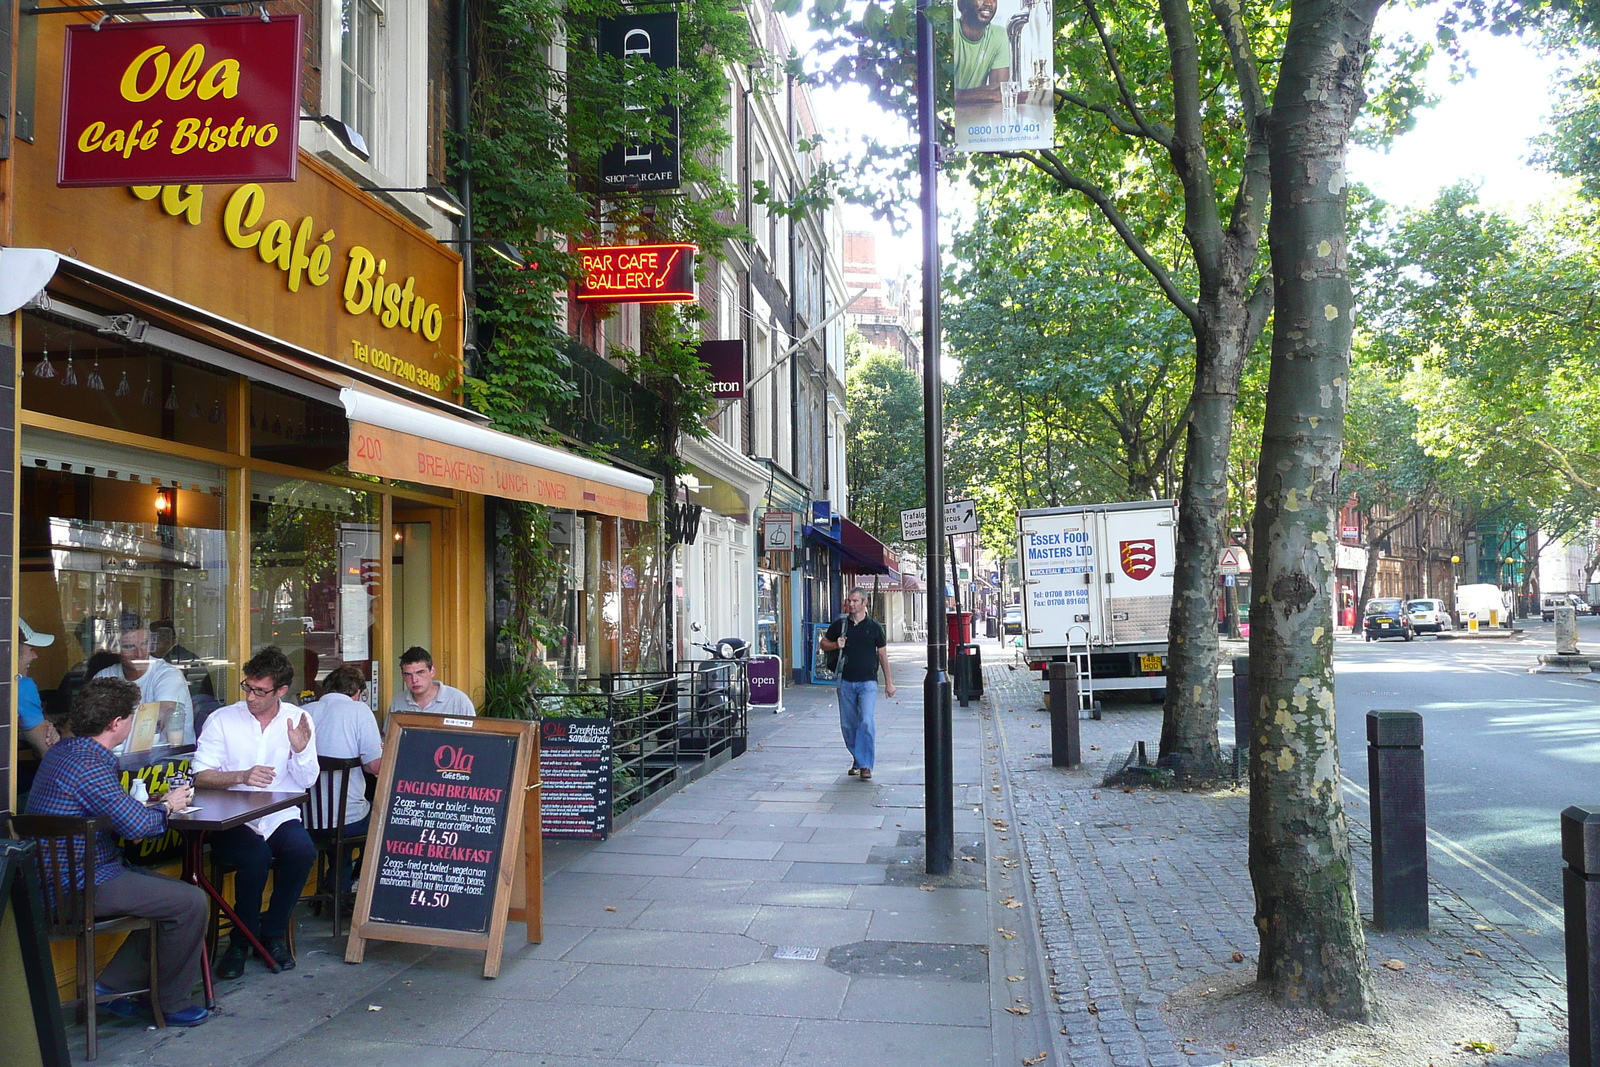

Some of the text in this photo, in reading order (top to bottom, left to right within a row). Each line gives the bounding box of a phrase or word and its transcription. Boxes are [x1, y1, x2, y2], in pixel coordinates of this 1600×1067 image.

[120, 43, 241, 102] Ola
[77, 116, 279, 159] Café Bistro
[968, 123, 1040, 135] 0800 10 70 401
[223, 183, 443, 342] Café Bistro
[583, 253, 659, 272] BAR CAFE
[586, 272, 655, 290] GALLERY
[351, 339, 441, 392] Tel 020 7240 3348
[356, 435, 382, 461] 200
[417, 452, 567, 500] BREAKFAST LUNCH DINNER
[903, 511, 926, 521] Trafalg
[1031, 532, 1089, 546] ESSEX FOOD
[1028, 545, 1093, 559] MASTERS LTD
[1044, 590, 1063, 598] 01708
[752, 676, 775, 687] open
[544, 721, 567, 736] Ola
[568, 723, 606, 737] Breakfast
[434, 744, 475, 771] Ola
[396, 779, 503, 803] ENGLISH BREAKFAST
[394, 795, 401, 806] 2
[400, 799, 417, 811] eggs
[420, 799, 436, 810] fried
[445, 801, 467, 813] boiled
[419, 828, 458, 846] £4.50
[386, 840, 493, 864] VEGGIE BREAKFAST
[383, 855, 390, 867] 2
[389, 860, 404, 870] eggs
[407, 859, 421, 870] fried
[421, 862, 430, 870] or
[429, 861, 449, 874] boiled
[452, 866, 487, 878] vegetarian
[410, 889, 450, 908] £4.50
